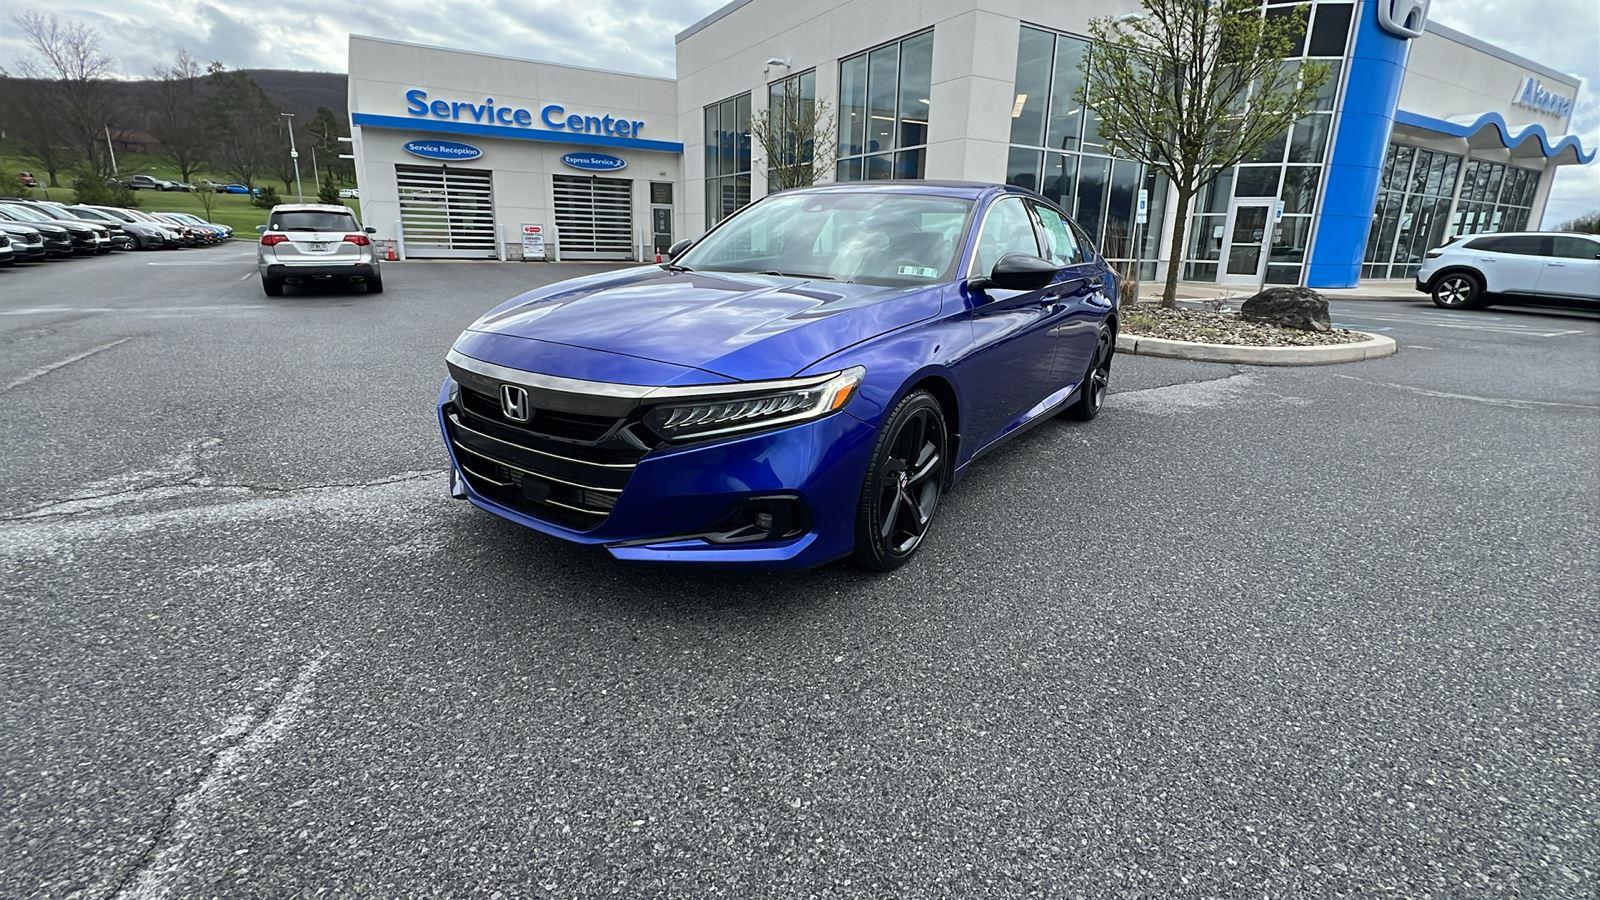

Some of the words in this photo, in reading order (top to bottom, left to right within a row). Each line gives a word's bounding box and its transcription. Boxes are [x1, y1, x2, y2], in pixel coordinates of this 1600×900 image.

[405, 89, 532, 126] Service
[541, 104, 645, 138] Center
[409, 143, 439, 152] Service
[440, 145, 478, 156] Reception
[565, 155, 590, 164] Express
[591, 157, 613, 166] Service
